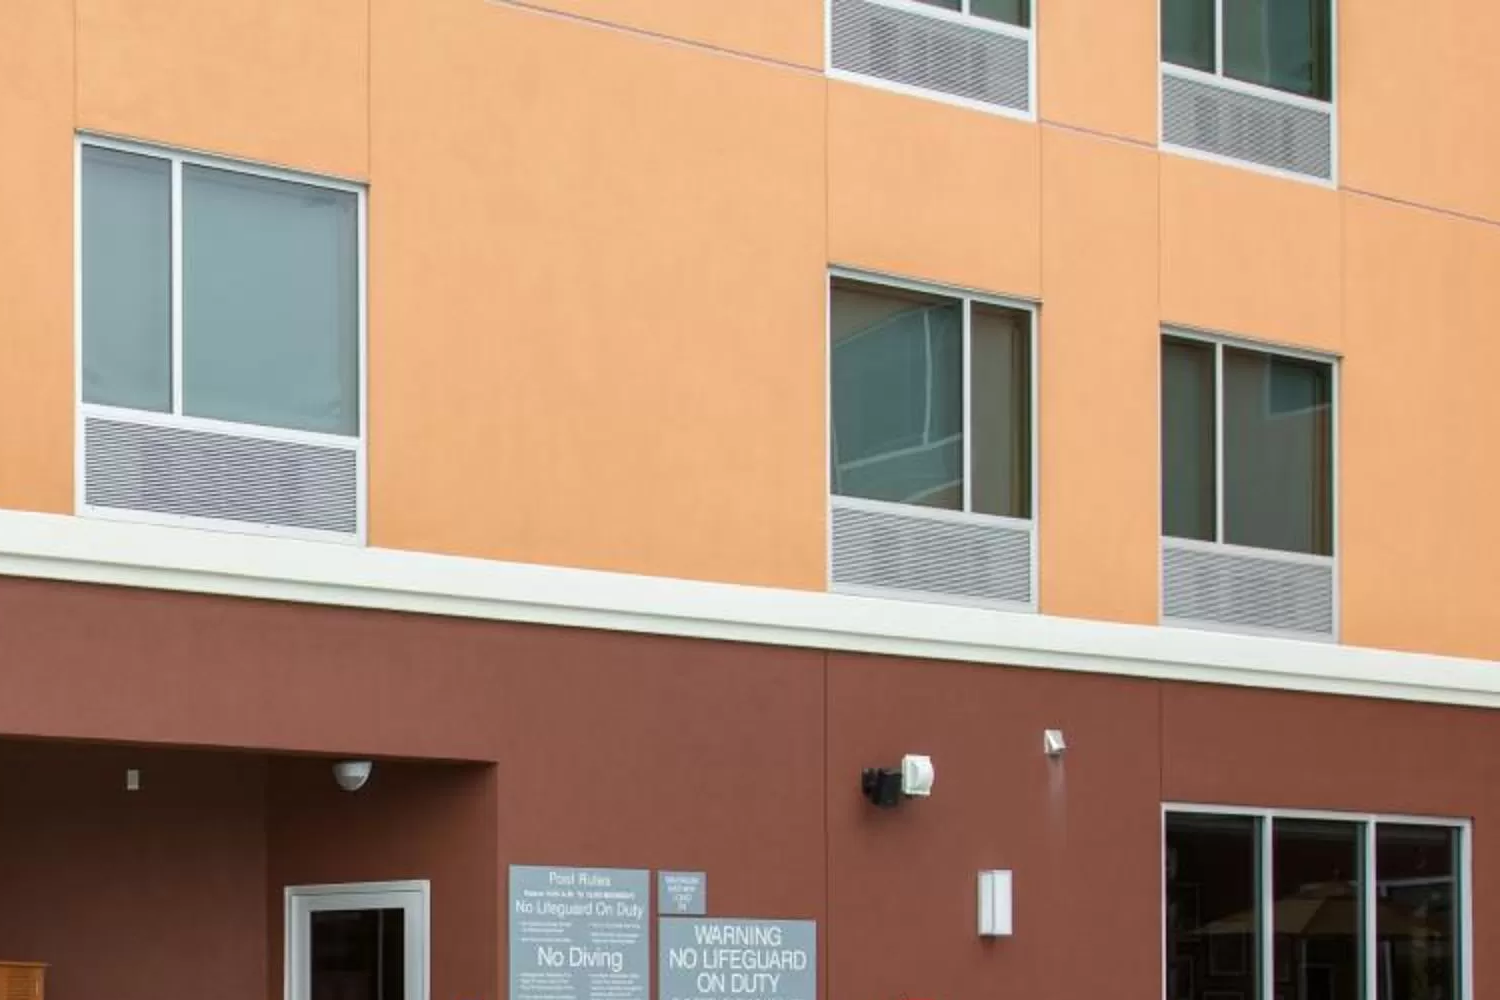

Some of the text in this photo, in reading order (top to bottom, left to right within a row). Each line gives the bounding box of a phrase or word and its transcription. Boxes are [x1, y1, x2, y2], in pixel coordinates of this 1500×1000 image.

[548, 871, 612, 887] Pool Rules
[515, 900, 644, 921] No Lifeguard On Duty
[693, 923, 782, 947] WARNING
[537, 945, 624, 973] No Diving
[668, 947, 808, 971] NO LIFEGUARD
[696, 971, 780, 993] ON DUTY
